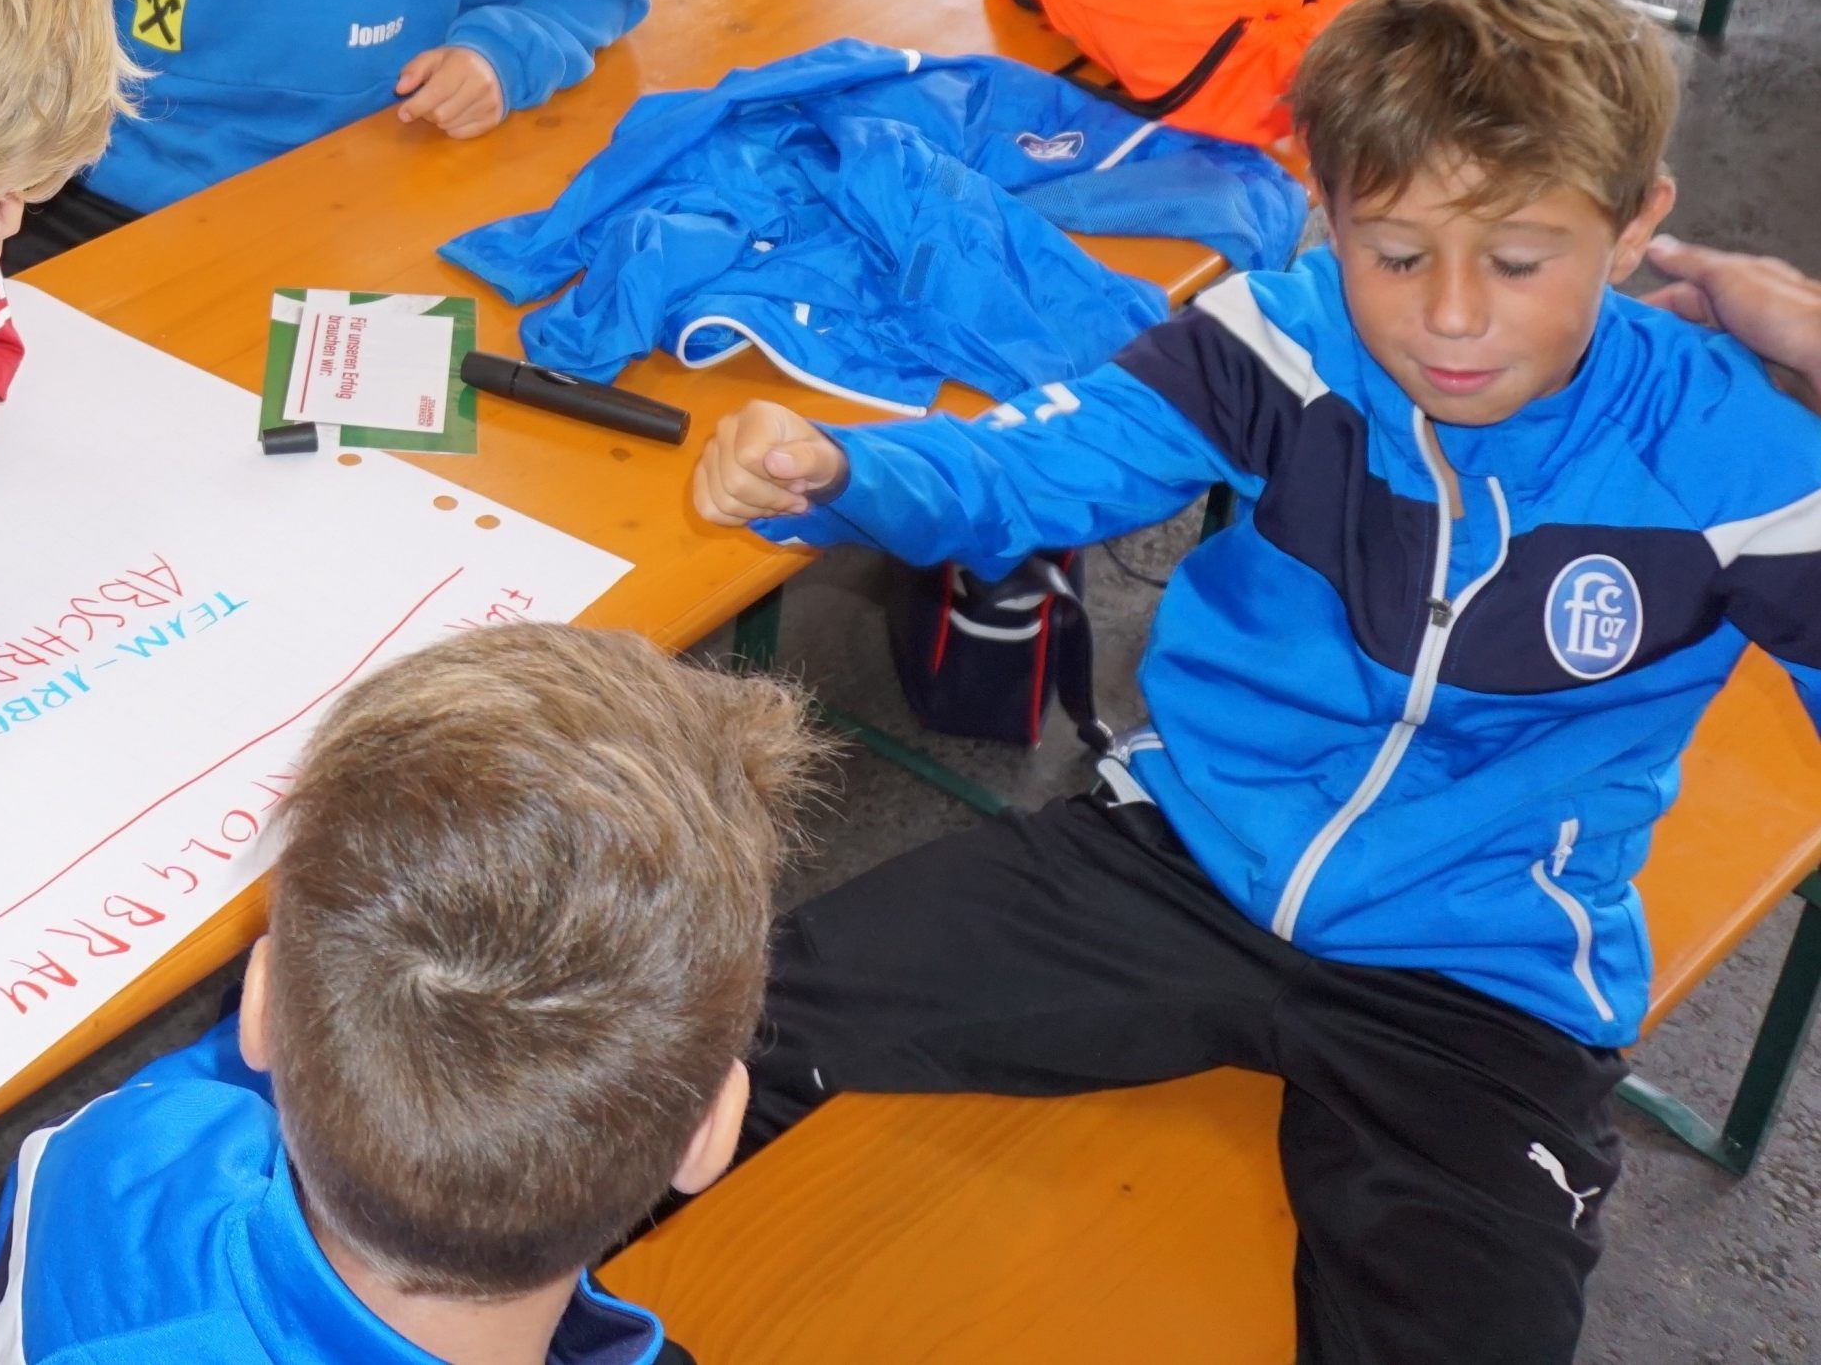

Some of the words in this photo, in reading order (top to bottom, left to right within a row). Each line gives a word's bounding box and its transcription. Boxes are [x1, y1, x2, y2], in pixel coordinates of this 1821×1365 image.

[349, 16, 405, 46] Jonas
[322, 315, 345, 357] brauchen
[349, 316, 367, 332] Für
[344, 334, 362, 370] unseren
[335, 372, 359, 400] Erfolg
